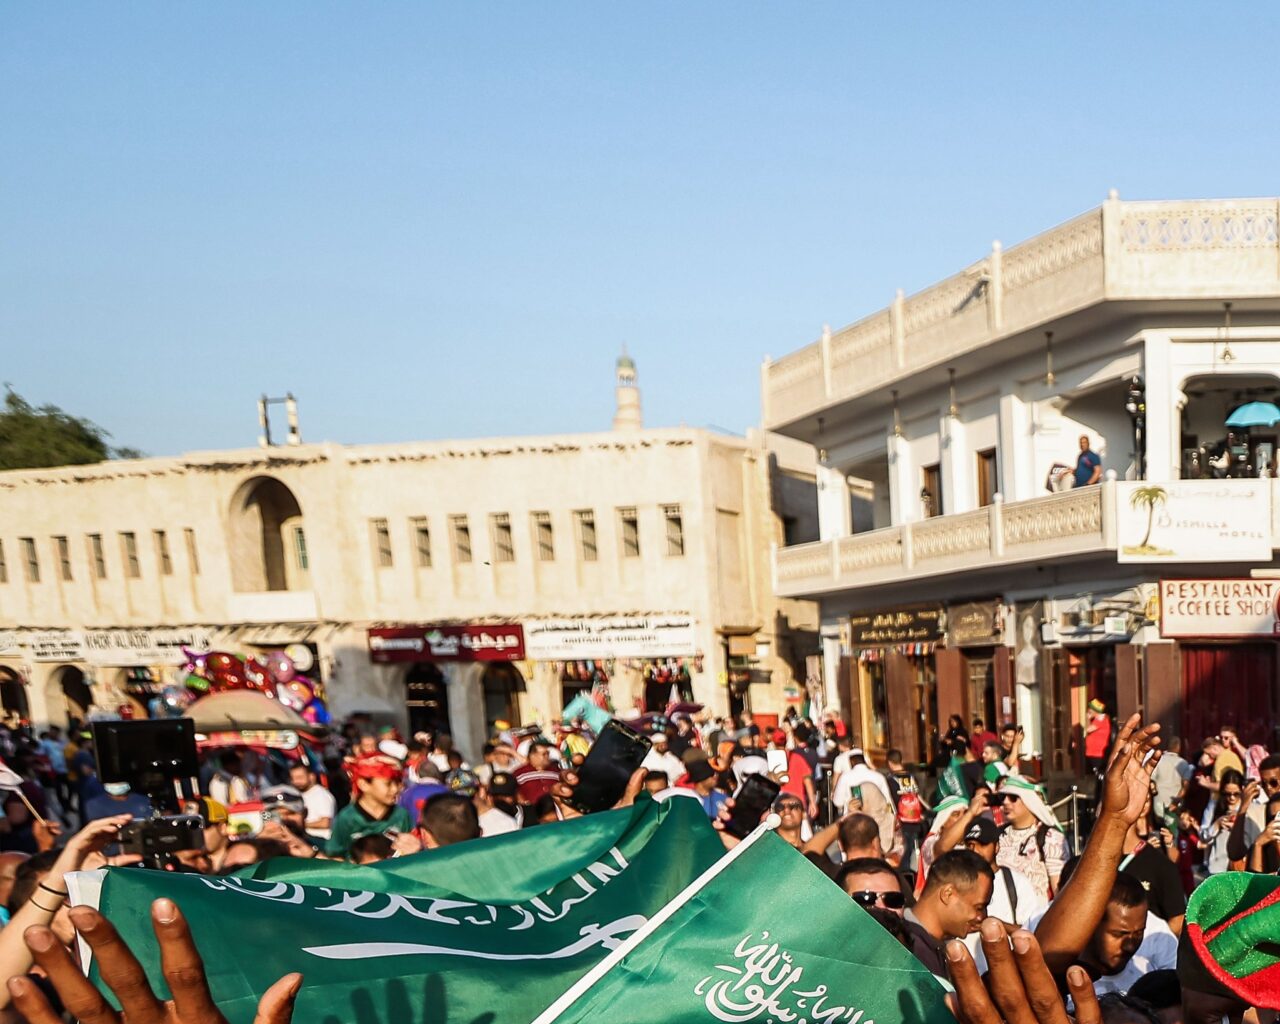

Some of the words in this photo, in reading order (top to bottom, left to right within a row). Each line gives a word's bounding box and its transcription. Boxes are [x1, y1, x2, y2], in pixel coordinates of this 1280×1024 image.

[1166, 583, 1273, 598] RESTAURANT
[1177, 601, 1231, 616] COFFEE
[1237, 601, 1273, 616] SHOP
